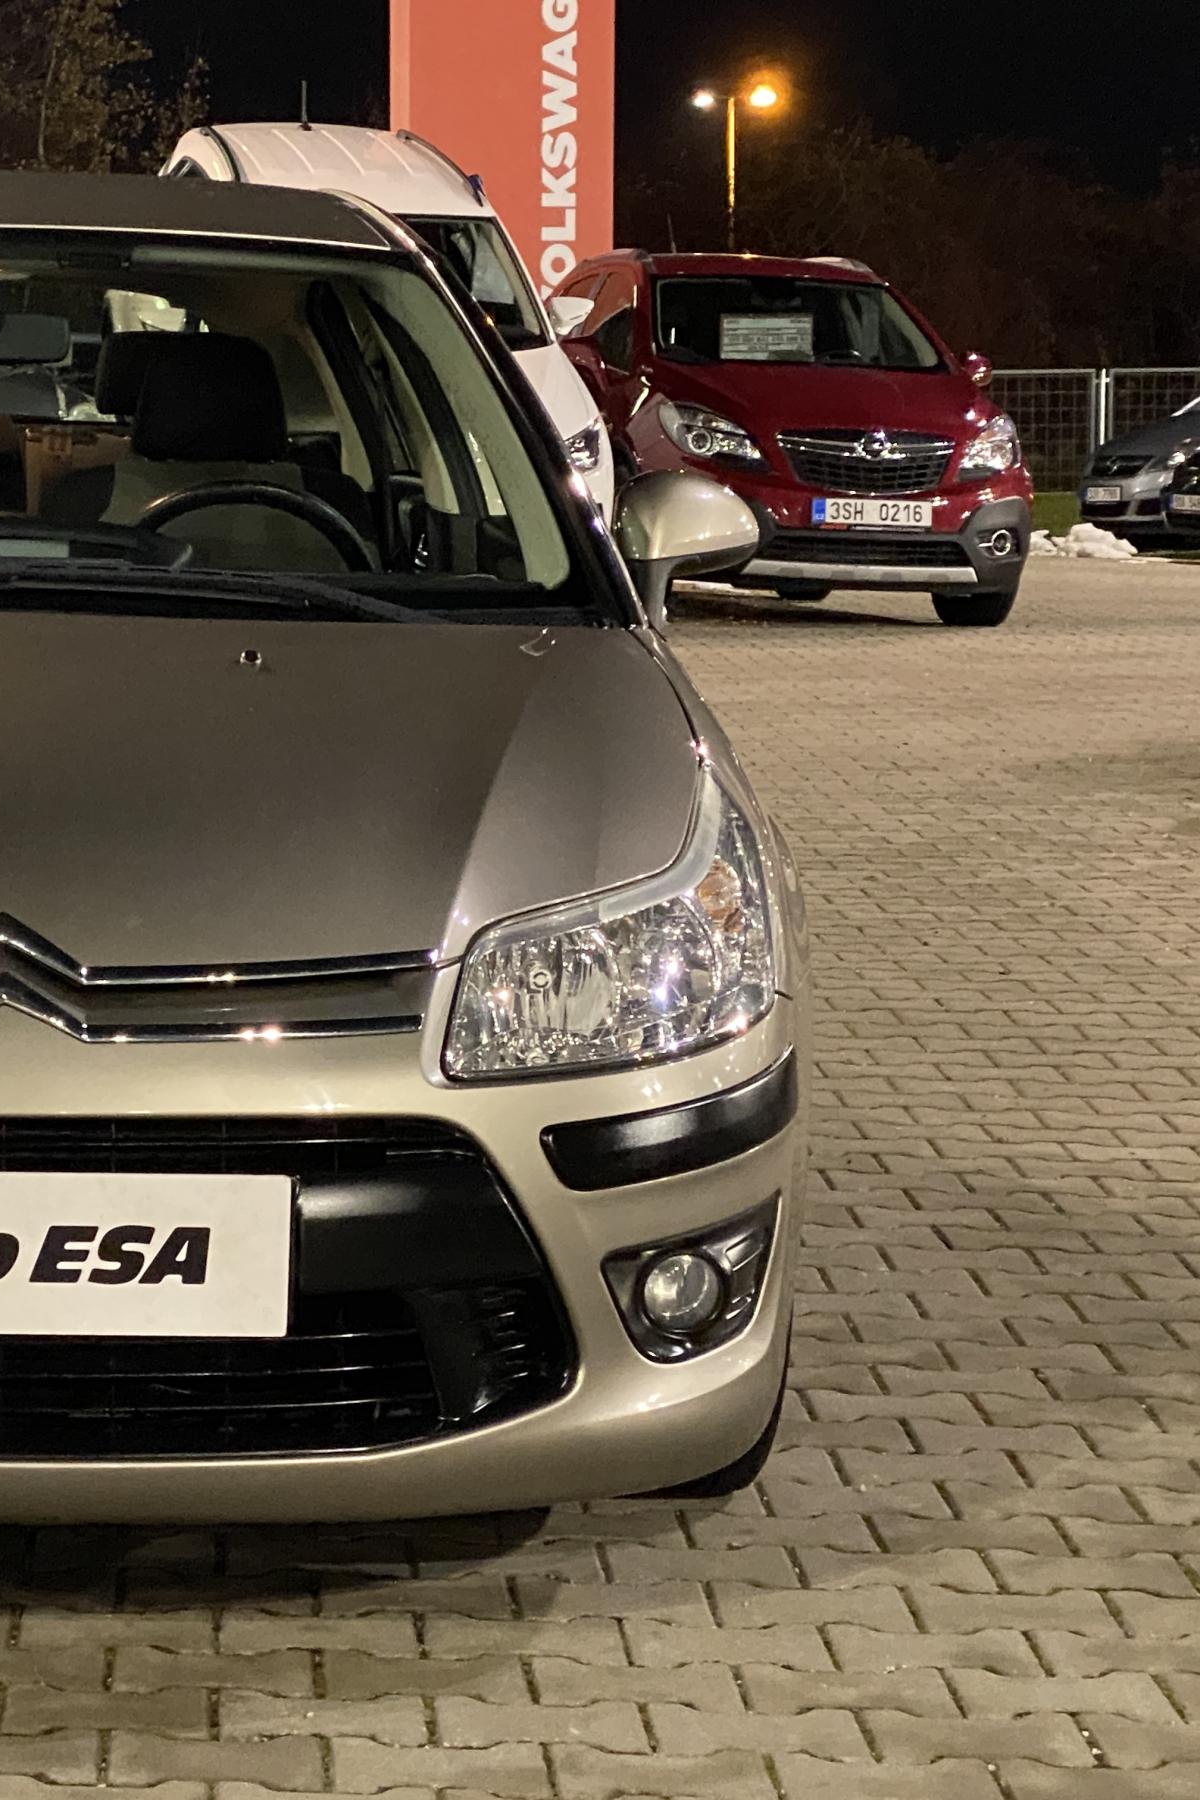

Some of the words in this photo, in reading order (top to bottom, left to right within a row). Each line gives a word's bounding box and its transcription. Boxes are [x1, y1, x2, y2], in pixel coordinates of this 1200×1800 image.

[540, 0, 579, 299] OLKSWAG
[830, 502, 864, 521] 3SH
[880, 503, 922, 523] 0216
[28, 1225, 211, 1285] ESA
